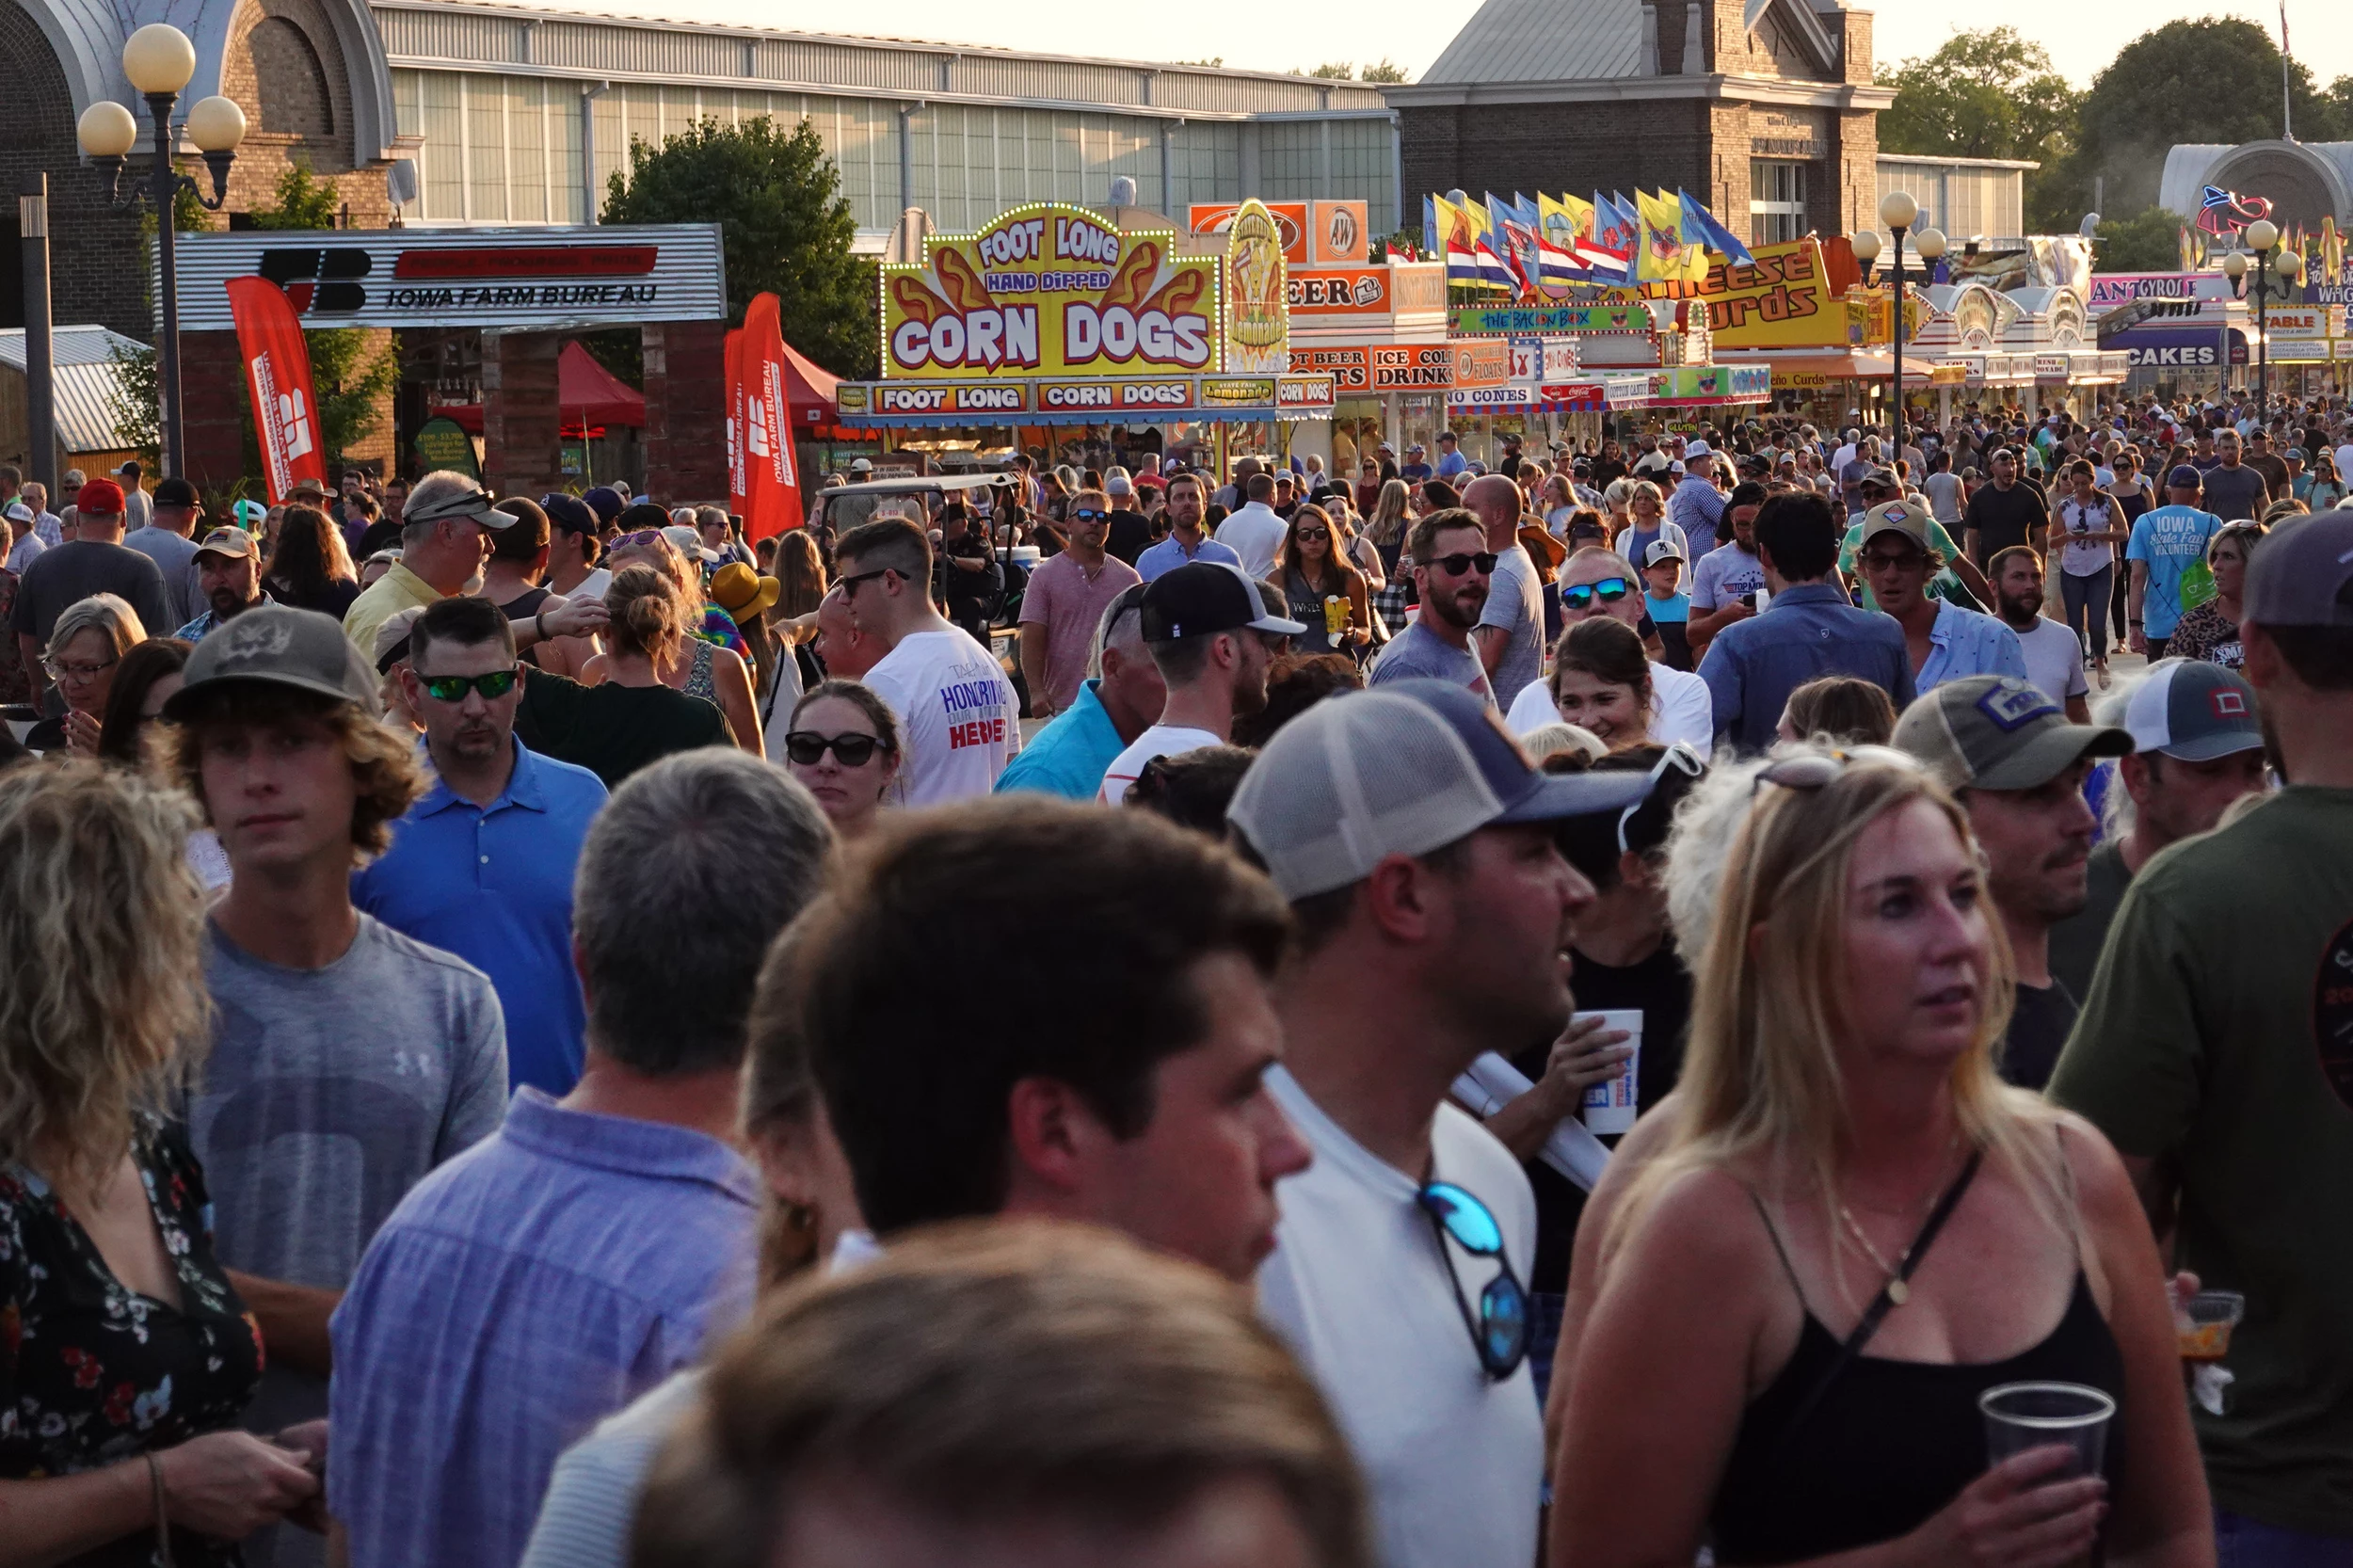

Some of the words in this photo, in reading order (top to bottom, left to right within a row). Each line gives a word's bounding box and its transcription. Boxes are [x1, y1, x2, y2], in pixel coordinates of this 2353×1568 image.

[980, 220, 1044, 266] FOOT
[1057, 218, 1120, 265] LONG
[987, 271, 1038, 291] HAND
[2139, 279, 2182, 297] GYROS
[387, 287, 455, 308] IOWA
[460, 286, 536, 306] FARM
[541, 284, 656, 304] BUREAU
[1707, 285, 1818, 331] urds
[1513, 311, 1556, 328] BACON
[1560, 310, 1590, 326] BOX
[893, 305, 1039, 371] CORN
[1064, 301, 1210, 366] DOGS
[1314, 352, 1365, 364] BEER
[1377, 351, 1409, 364] ICE
[1419, 350, 1453, 363] COLD
[2129, 346, 2215, 366] CAKES
[1377, 367, 1454, 386] DRINKS
[1474, 361, 1503, 380] FLOATS
[762, 360, 776, 414] BUREAU
[1793, 375, 1825, 386] Curds
[883, 389, 947, 409] FOOT
[956, 387, 1020, 408] LONG
[1047, 386, 1112, 407] CORN
[1123, 384, 1187, 405] DOGS
[1206, 386, 1272, 401] Lemonade
[1280, 384, 1305, 403] CORN
[1306, 382, 1330, 403] DOGS
[1472, 389, 1528, 403] CONES
[1609, 385, 1629, 399] COTTON
[1630, 382, 1648, 396] CANDY
[767, 414, 779, 452] FARM
[1668, 423, 1698, 432] GLUTEN
[772, 450, 784, 484] IOWA
[2156, 517, 2196, 534] IOWA
[2150, 533, 2178, 547] State
[2153, 544, 2201, 556] VOLUNTEER
[1734, 582, 1748, 591] TOP
[948, 709, 971, 726] OUR
